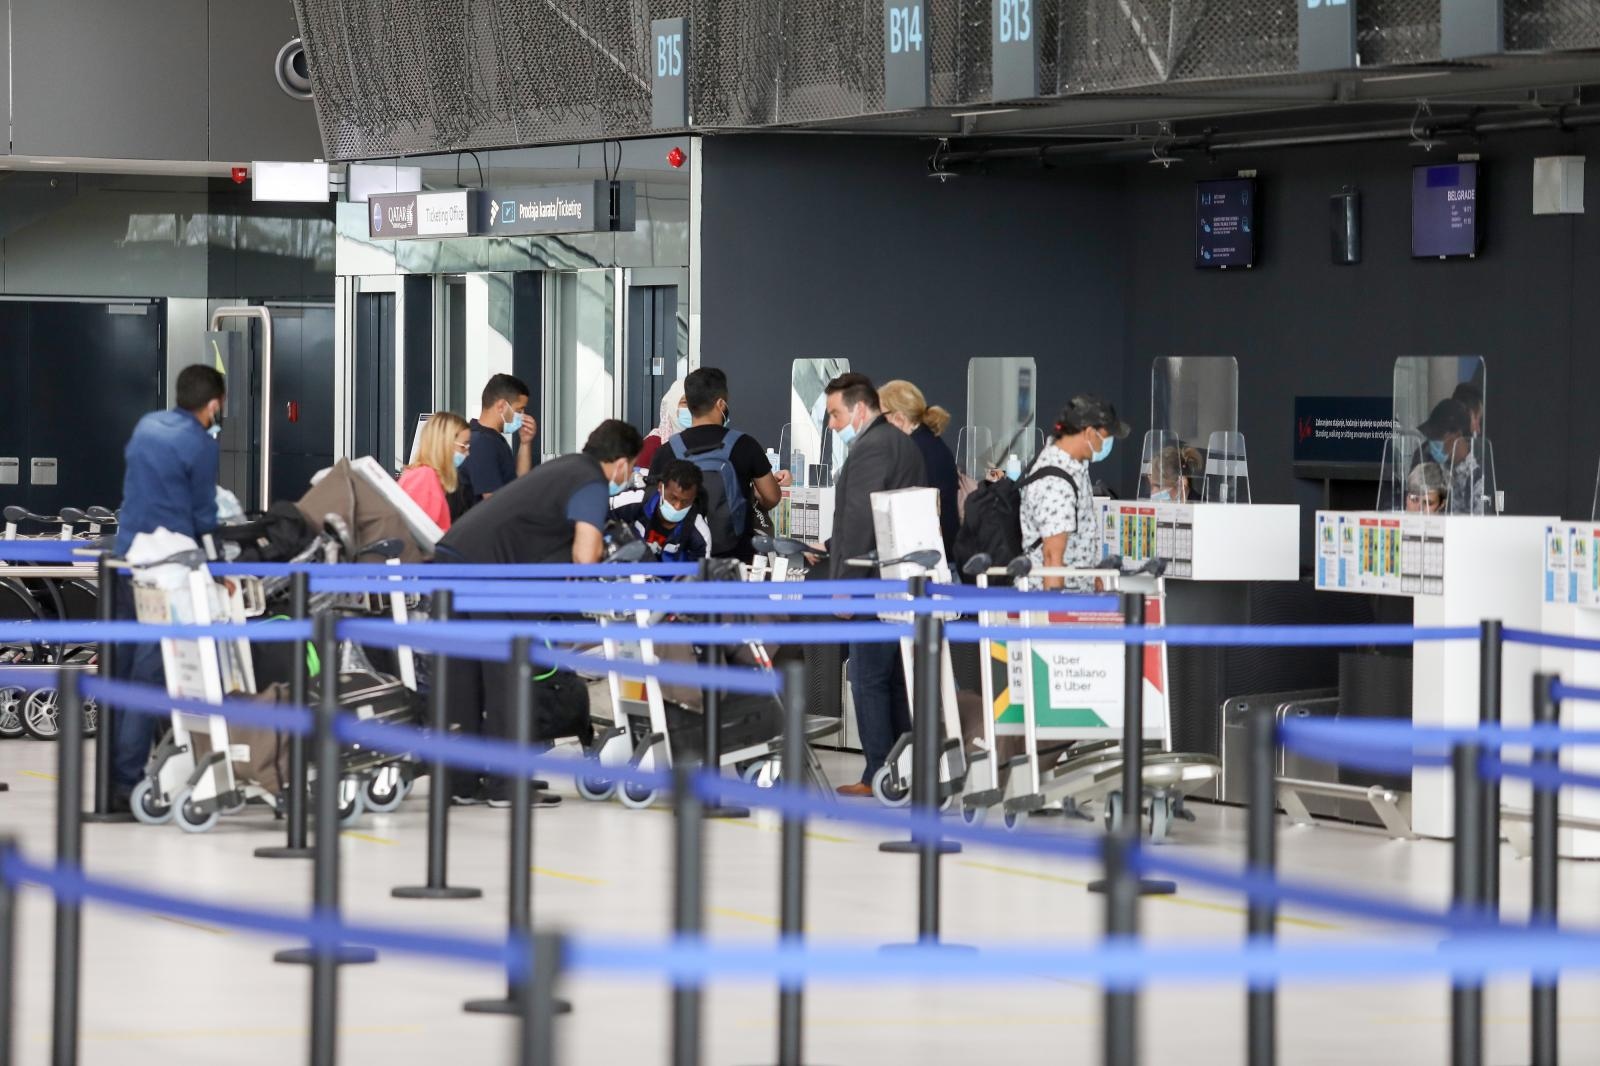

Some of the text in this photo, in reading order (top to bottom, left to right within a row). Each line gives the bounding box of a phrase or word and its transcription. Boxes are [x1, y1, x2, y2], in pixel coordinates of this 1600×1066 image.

[890, 5, 922, 53] B14
[1000, 0, 1031, 43] B13
[658, 34, 682, 77] B15
[1447, 189, 1475, 201] BELGRADE
[388, 206, 407, 223] QATAR
[425, 207, 449, 226] Ticketing
[449, 205, 465, 222] Office
[519, 202, 539, 221] Prodaja
[1053, 655, 1080, 665] Uber
[1054, 668, 1107, 678] in Italiano
[1064, 681, 1092, 691] Uber
